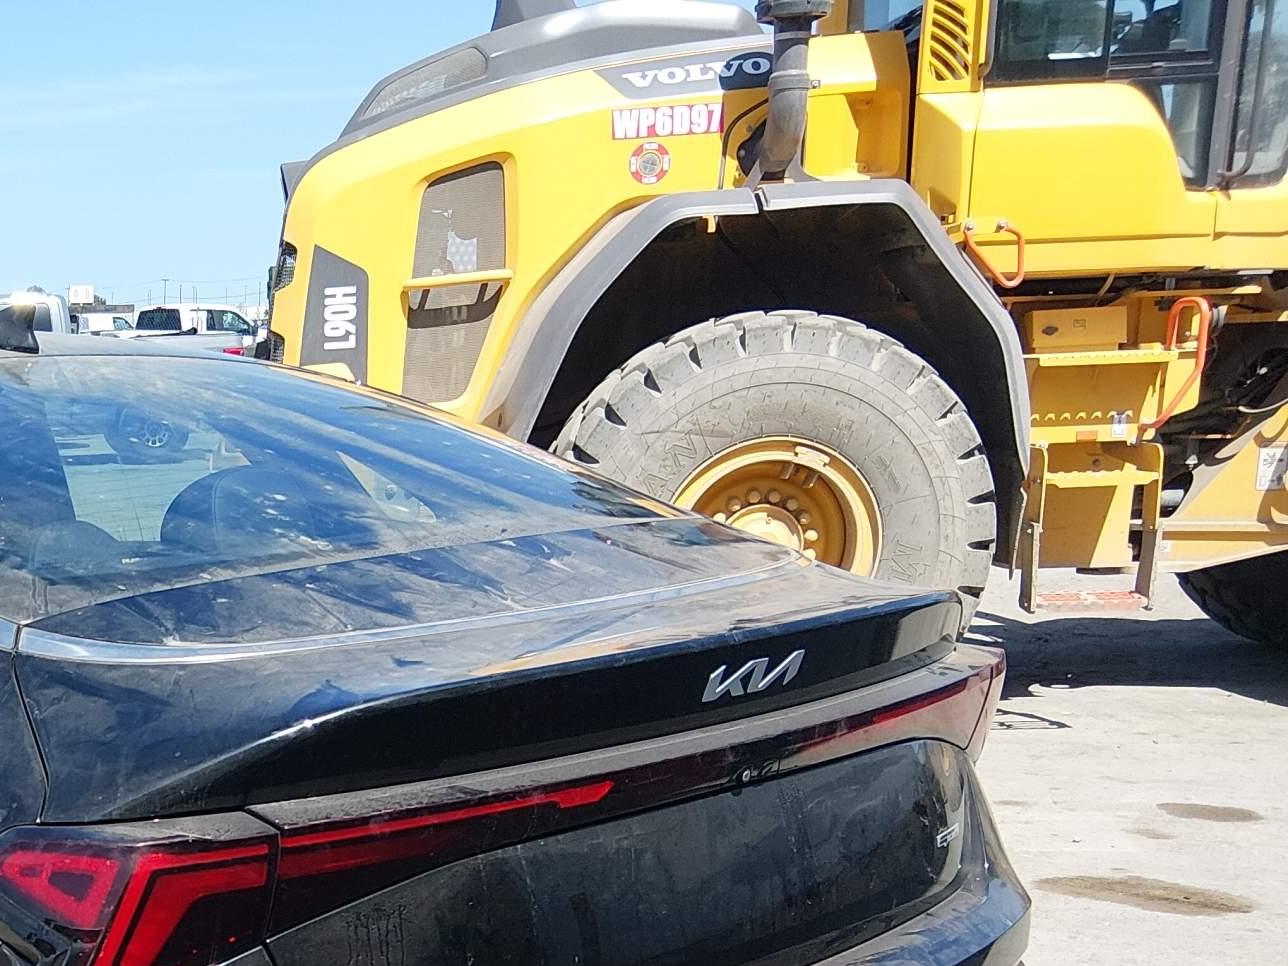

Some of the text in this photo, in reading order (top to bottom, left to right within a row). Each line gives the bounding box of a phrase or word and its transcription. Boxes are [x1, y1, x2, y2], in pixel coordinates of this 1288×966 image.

[621, 57, 771, 88] VOLVO
[612, 103, 723, 139] WP6D97
[323, 285, 357, 350] L90H
[701, 649, 806, 702] KIA
